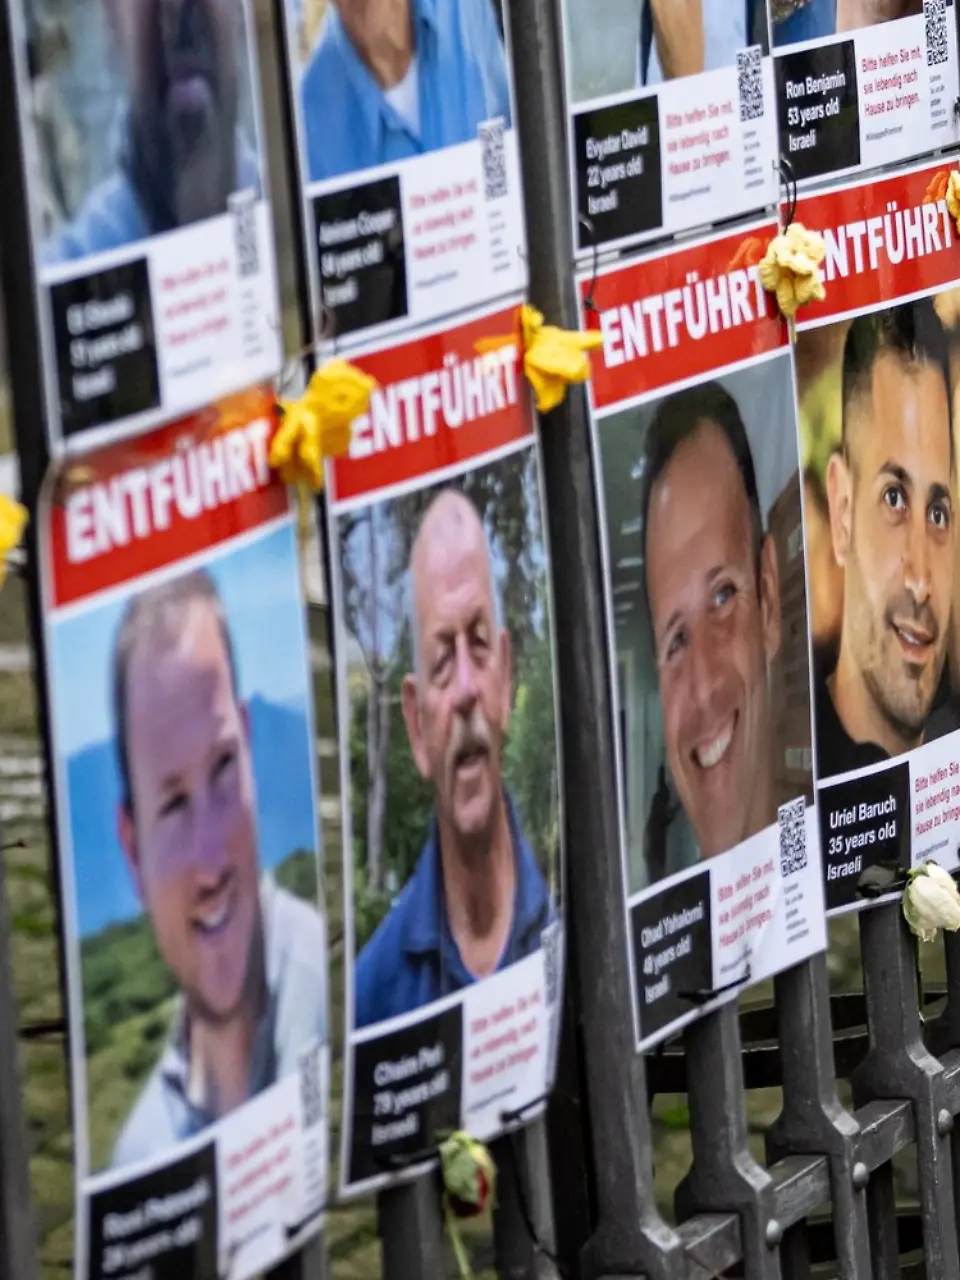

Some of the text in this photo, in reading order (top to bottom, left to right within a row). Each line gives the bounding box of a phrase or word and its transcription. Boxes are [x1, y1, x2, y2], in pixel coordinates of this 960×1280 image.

[786, 70, 846, 99] Ron Benjamin
[788, 97, 840, 127] 53 years old
[789, 130, 817, 151] Israeli
[818, 202, 953, 284] NTFÜHRT
[600, 265, 767, 369] ENTFÜHRT
[65, 418, 272, 564] ENTFÜHRT
[830, 795, 897, 828] Uriel Baruch
[829, 820, 897, 854] 35 years old
[828, 855, 862, 880] Israeli
